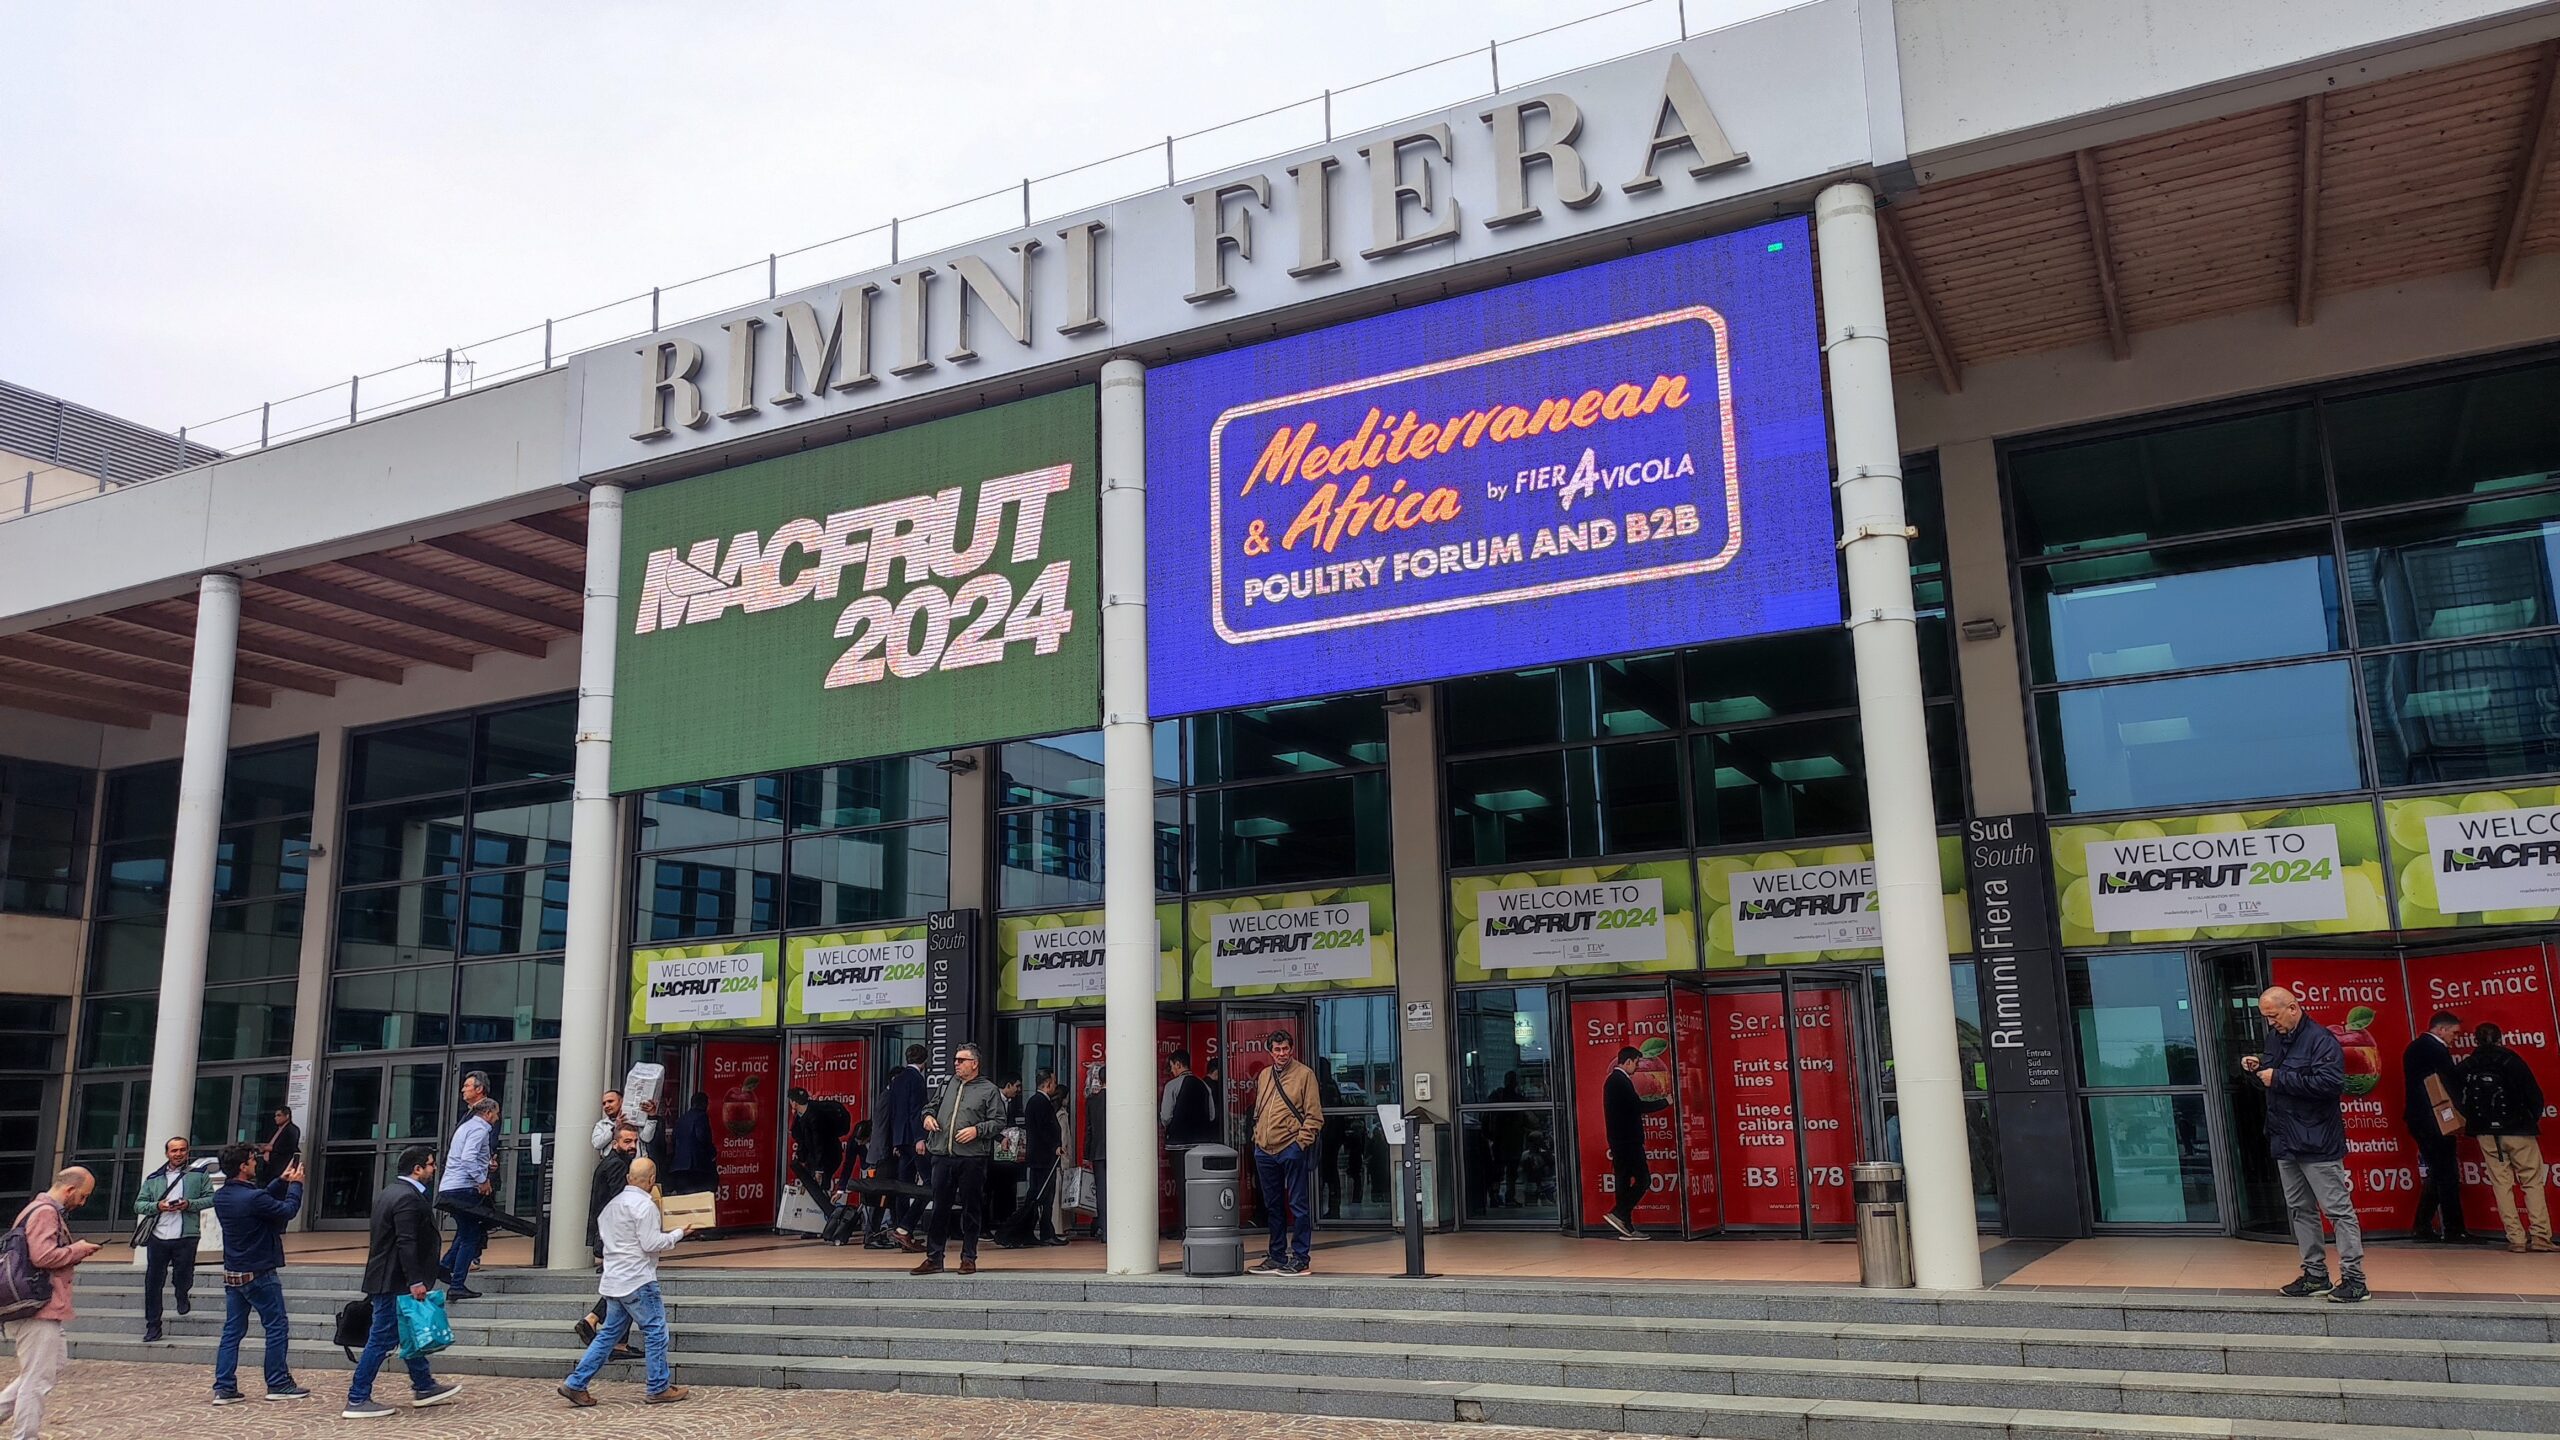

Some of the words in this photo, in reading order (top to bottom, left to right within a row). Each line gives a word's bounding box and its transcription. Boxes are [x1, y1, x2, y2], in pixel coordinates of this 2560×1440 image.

[631, 219, 1108, 443] RIMINI
[1181, 52, 1750, 305] FIERA
[1241, 375, 1690, 497] Mediterranean
[1487, 482, 1508, 501] by
[1243, 519, 1269, 557] &
[1281, 475, 1461, 552] Africa
[635, 463, 1073, 634] MACFRUT
[1243, 556, 1382, 606] POULTRY
[1392, 533, 1524, 585] FORUM
[1530, 517, 1617, 560] AND
[1626, 503, 1700, 545] B2B
[824, 560, 1074, 689] 2024
[1970, 818, 2013, 842] Sud
[1974, 843, 2034, 868] South
[2114, 838, 2258, 865] WELCOME
[2264, 833, 2305, 854] TO
[1752, 867, 1873, 894] WELCOME
[2099, 863, 2249, 895] MACFRUT
[2248, 857, 2332, 886] 2024
[1498, 888, 1604, 911] WELCOME
[1609, 886, 1639, 903] TO
[1739, 891, 1864, 921] MACFRUT
[930, 912, 955, 930] Sud
[1229, 911, 1321, 933] WELCOME
[1324, 909, 1349, 926] TO
[1485, 911, 1596, 937] MACFRUT
[1595, 907, 1658, 929] 2024
[1980, 879, 2013, 949] Fiera
[930, 932, 966, 951] South
[1217, 932, 1313, 958] MACFRUT
[1312, 928, 1366, 950] 2024
[818, 947, 890, 966] WELCOME
[892, 944, 914, 959] TO
[1022, 949, 1106, 972] MACFRUT
[661, 960, 727, 977] WELCOME
[730, 958, 749, 973] TO
[807, 965, 884, 987] MACFRUT
[883, 962, 925, 981] 2024
[651, 978, 721, 998] MACFRUT
[720, 976, 758, 993] 2024
[928, 959, 948, 1012] Fiera
[2292, 980, 2387, 1002] Ser.mac
[2430, 972, 2539, 999] Ser.mac
[1587, 1014, 1669, 1037] Ser.ma
[714, 1057, 769, 1073] Ser.mac
[794, 1057, 857, 1073] Ser.mac
[927, 1018, 948, 1088] Rimini
[1733, 1058, 1770, 1073] Fruit
[1774, 1056, 1833, 1072] soting
[1734, 1074, 1773, 1087] lines
[2030, 1078, 2050, 1086] South
[1737, 1103, 1780, 1116] Linee
[2340, 1098, 2383, 1115] orting
[1738, 1116, 1839, 1131] calibraione
[723, 1137, 754, 1149] Sorting
[1739, 1132, 1785, 1146] frutta
[1747, 1167, 1778, 1187] B3
[2369, 1167, 2413, 1191] 078
[738, 1183, 764, 1199] 078
